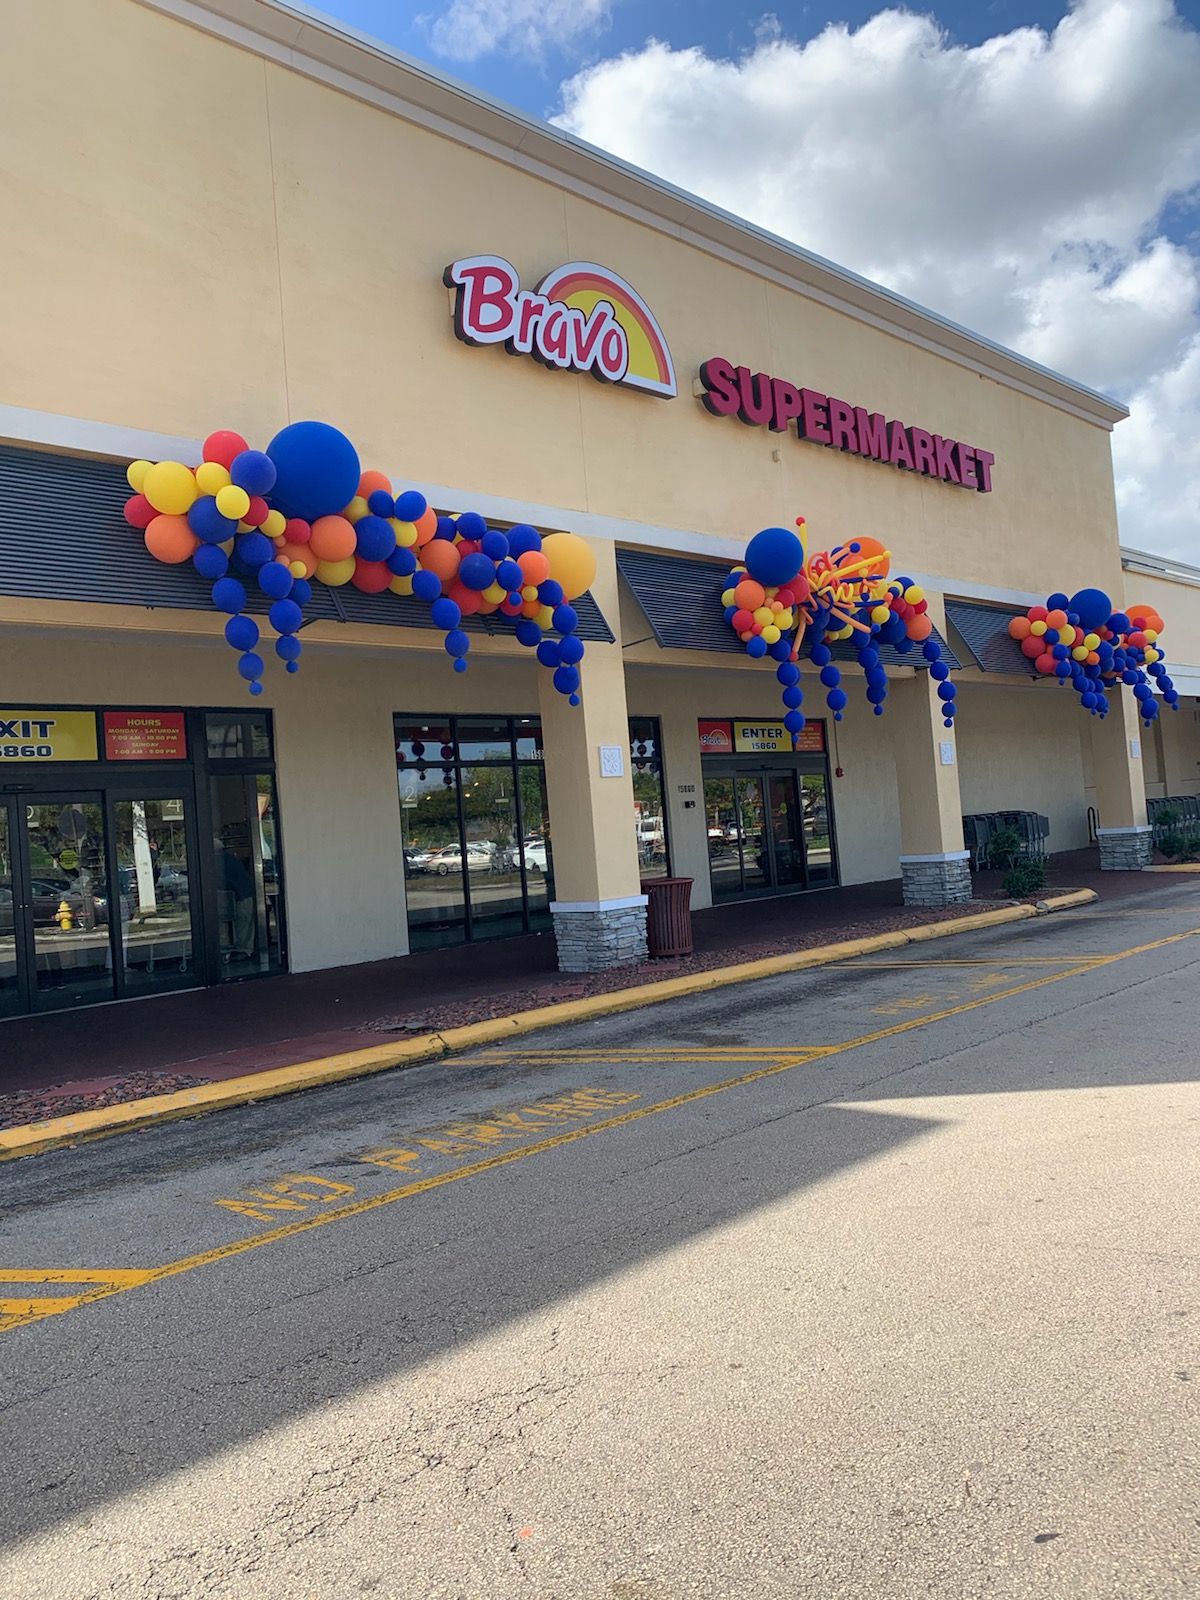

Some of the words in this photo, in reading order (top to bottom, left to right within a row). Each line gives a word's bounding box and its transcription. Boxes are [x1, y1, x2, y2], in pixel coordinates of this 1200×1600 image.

[451, 259, 627, 377] Bravo
[700, 357, 995, 493] SUPERMARKET
[0, 745, 53, 758] 860
[742, 728, 783, 738] ENTER
[751, 742, 777, 750] 15860
[215, 1174, 357, 1221] NO
[361, 1087, 642, 1174] PARKING
